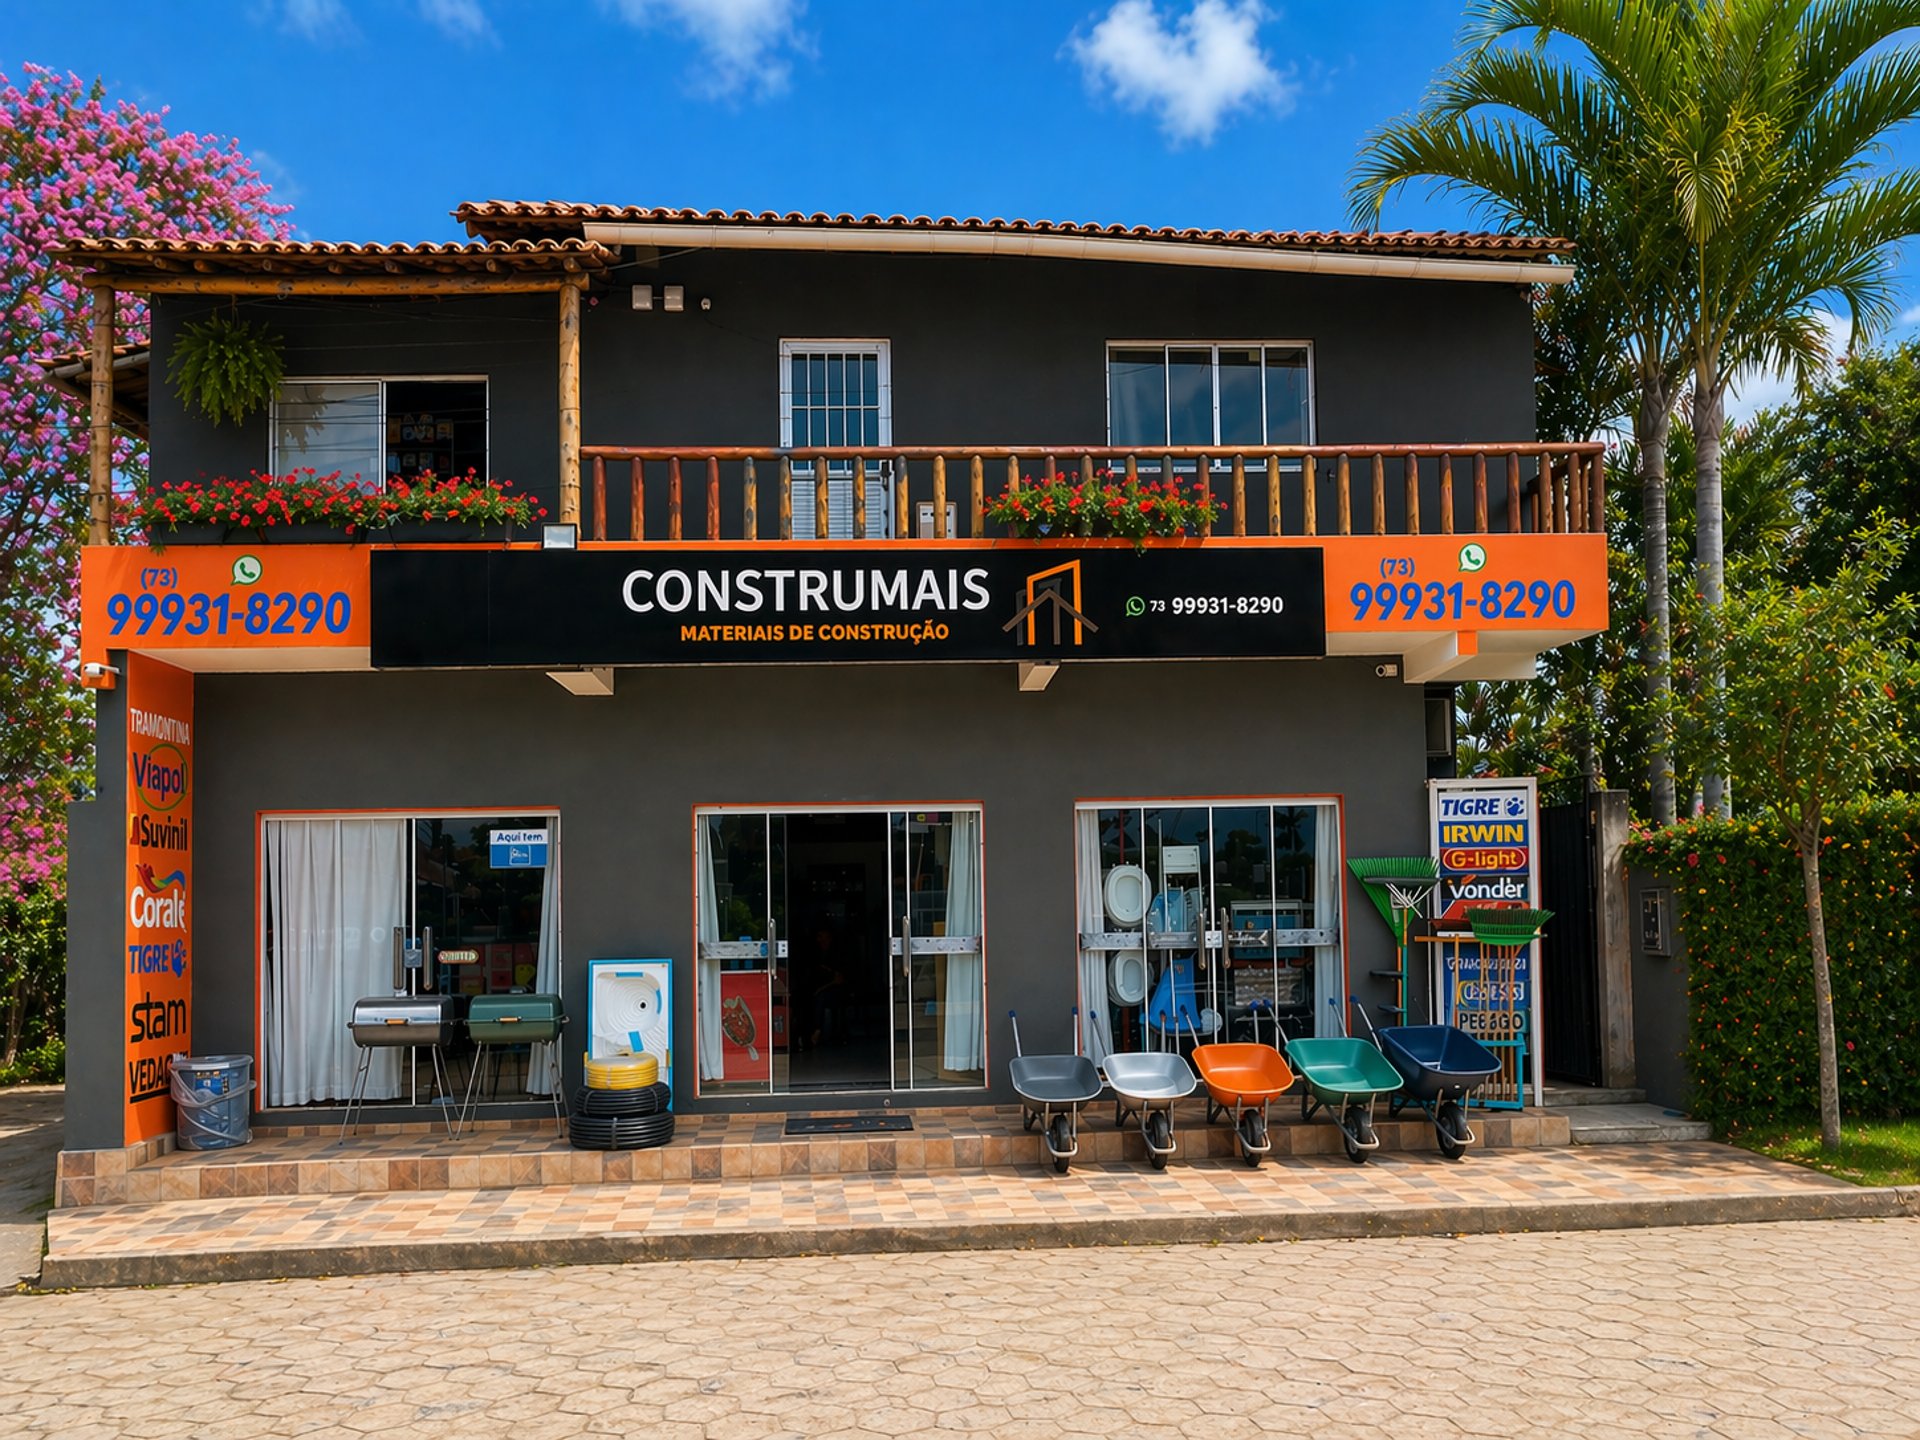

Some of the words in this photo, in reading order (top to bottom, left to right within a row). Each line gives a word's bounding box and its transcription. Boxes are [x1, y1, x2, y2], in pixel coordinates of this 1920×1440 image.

[140, 568, 178, 590] (73)
[1380, 557, 1415, 578] (73)
[622, 567, 991, 614] CONSTRUMAIS
[1350, 579, 1576, 621] 99931-8290
[107, 591, 352, 636] 99931-8290
[1150, 599, 1166, 613] 73
[1172, 596, 1284, 615] 99931-8290
[680, 624, 784, 642] MATERIAIS
[789, 624, 814, 641] DE
[819, 619, 949, 645] CONSTRUÇÃO
[130, 707, 190, 746] TRAMONTINA
[133, 752, 186, 802] Viapol
[1442, 797, 1501, 816] TIGRE
[141, 813, 188, 851] Suvinil
[497, 832, 521, 843] Aqui
[1443, 824, 1524, 844] IRWIN
[1451, 851, 1518, 870] G-light
[128, 944, 169, 974] TIGRE
[130, 991, 186, 1043] stam
